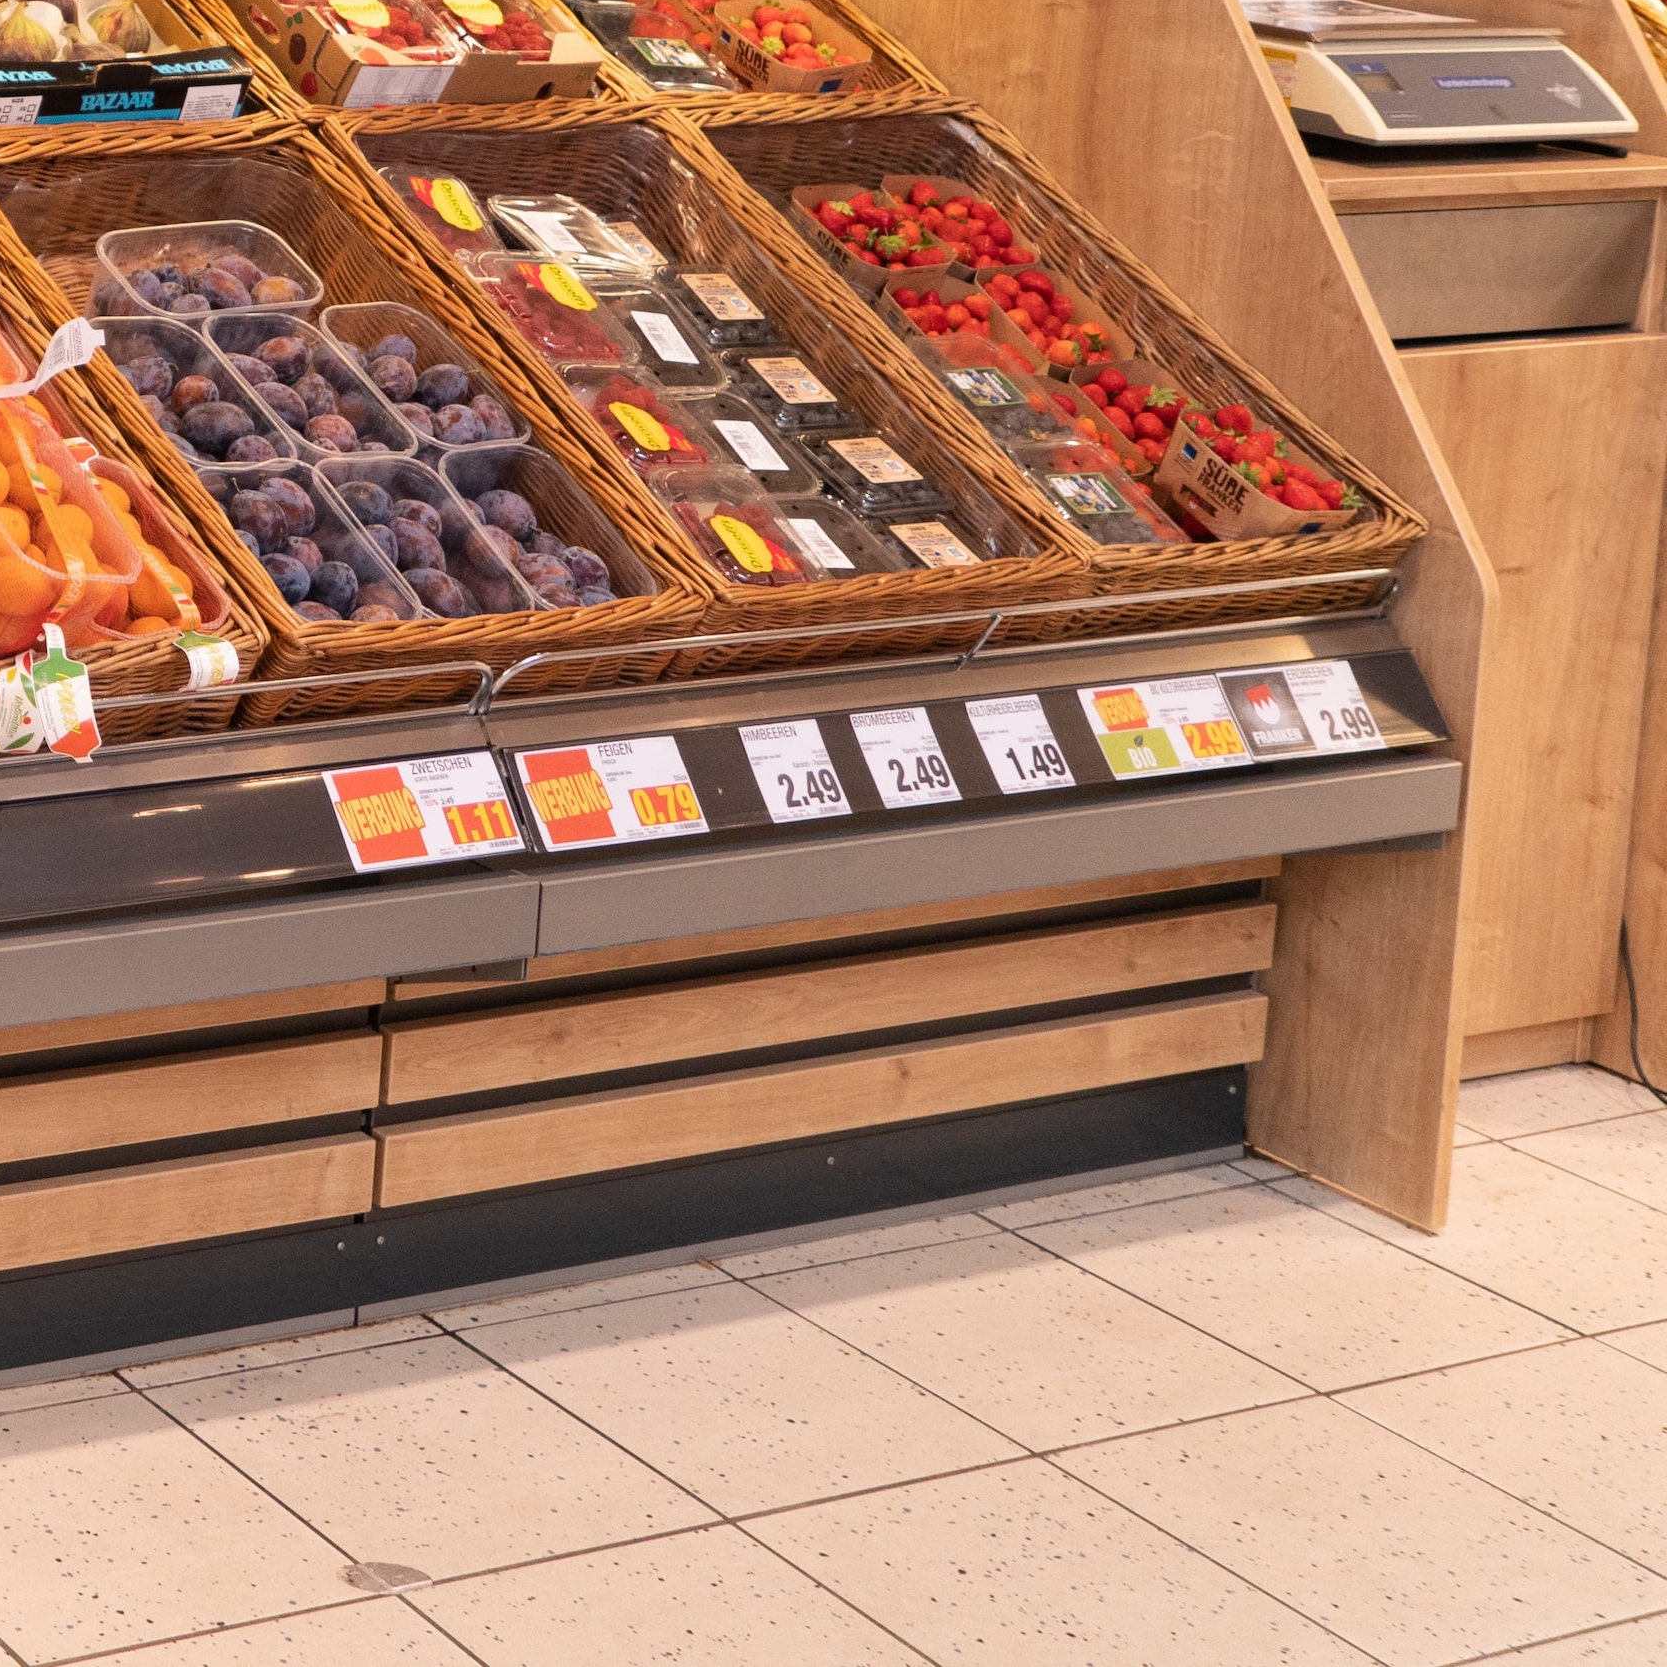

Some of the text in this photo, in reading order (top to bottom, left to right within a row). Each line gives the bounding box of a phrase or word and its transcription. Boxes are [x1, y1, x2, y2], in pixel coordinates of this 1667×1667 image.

[80, 90, 155, 111] BAZAAR
[851, 709, 916, 729] BROMBEEREN
[1093, 690, 1150, 726] WERBUNG
[1320, 706, 1376, 741] 2.99
[598, 742, 633, 758] FEIGEN
[742, 725, 797, 742] HIMBEEREN
[1184, 721, 1243, 757] 2.99
[409, 756, 473, 776] ZWETSCHEN
[887, 754, 951, 793] 2.49
[1005, 743, 1066, 781] 1.49
[1127, 746, 1159, 769] BIO
[525, 768, 613, 824] WERBUNG
[632, 783, 701, 826] 0.79
[777, 768, 841, 808] 2.49
[335, 786, 426, 843] WERBUNG
[447, 801, 515, 845] 1.11
